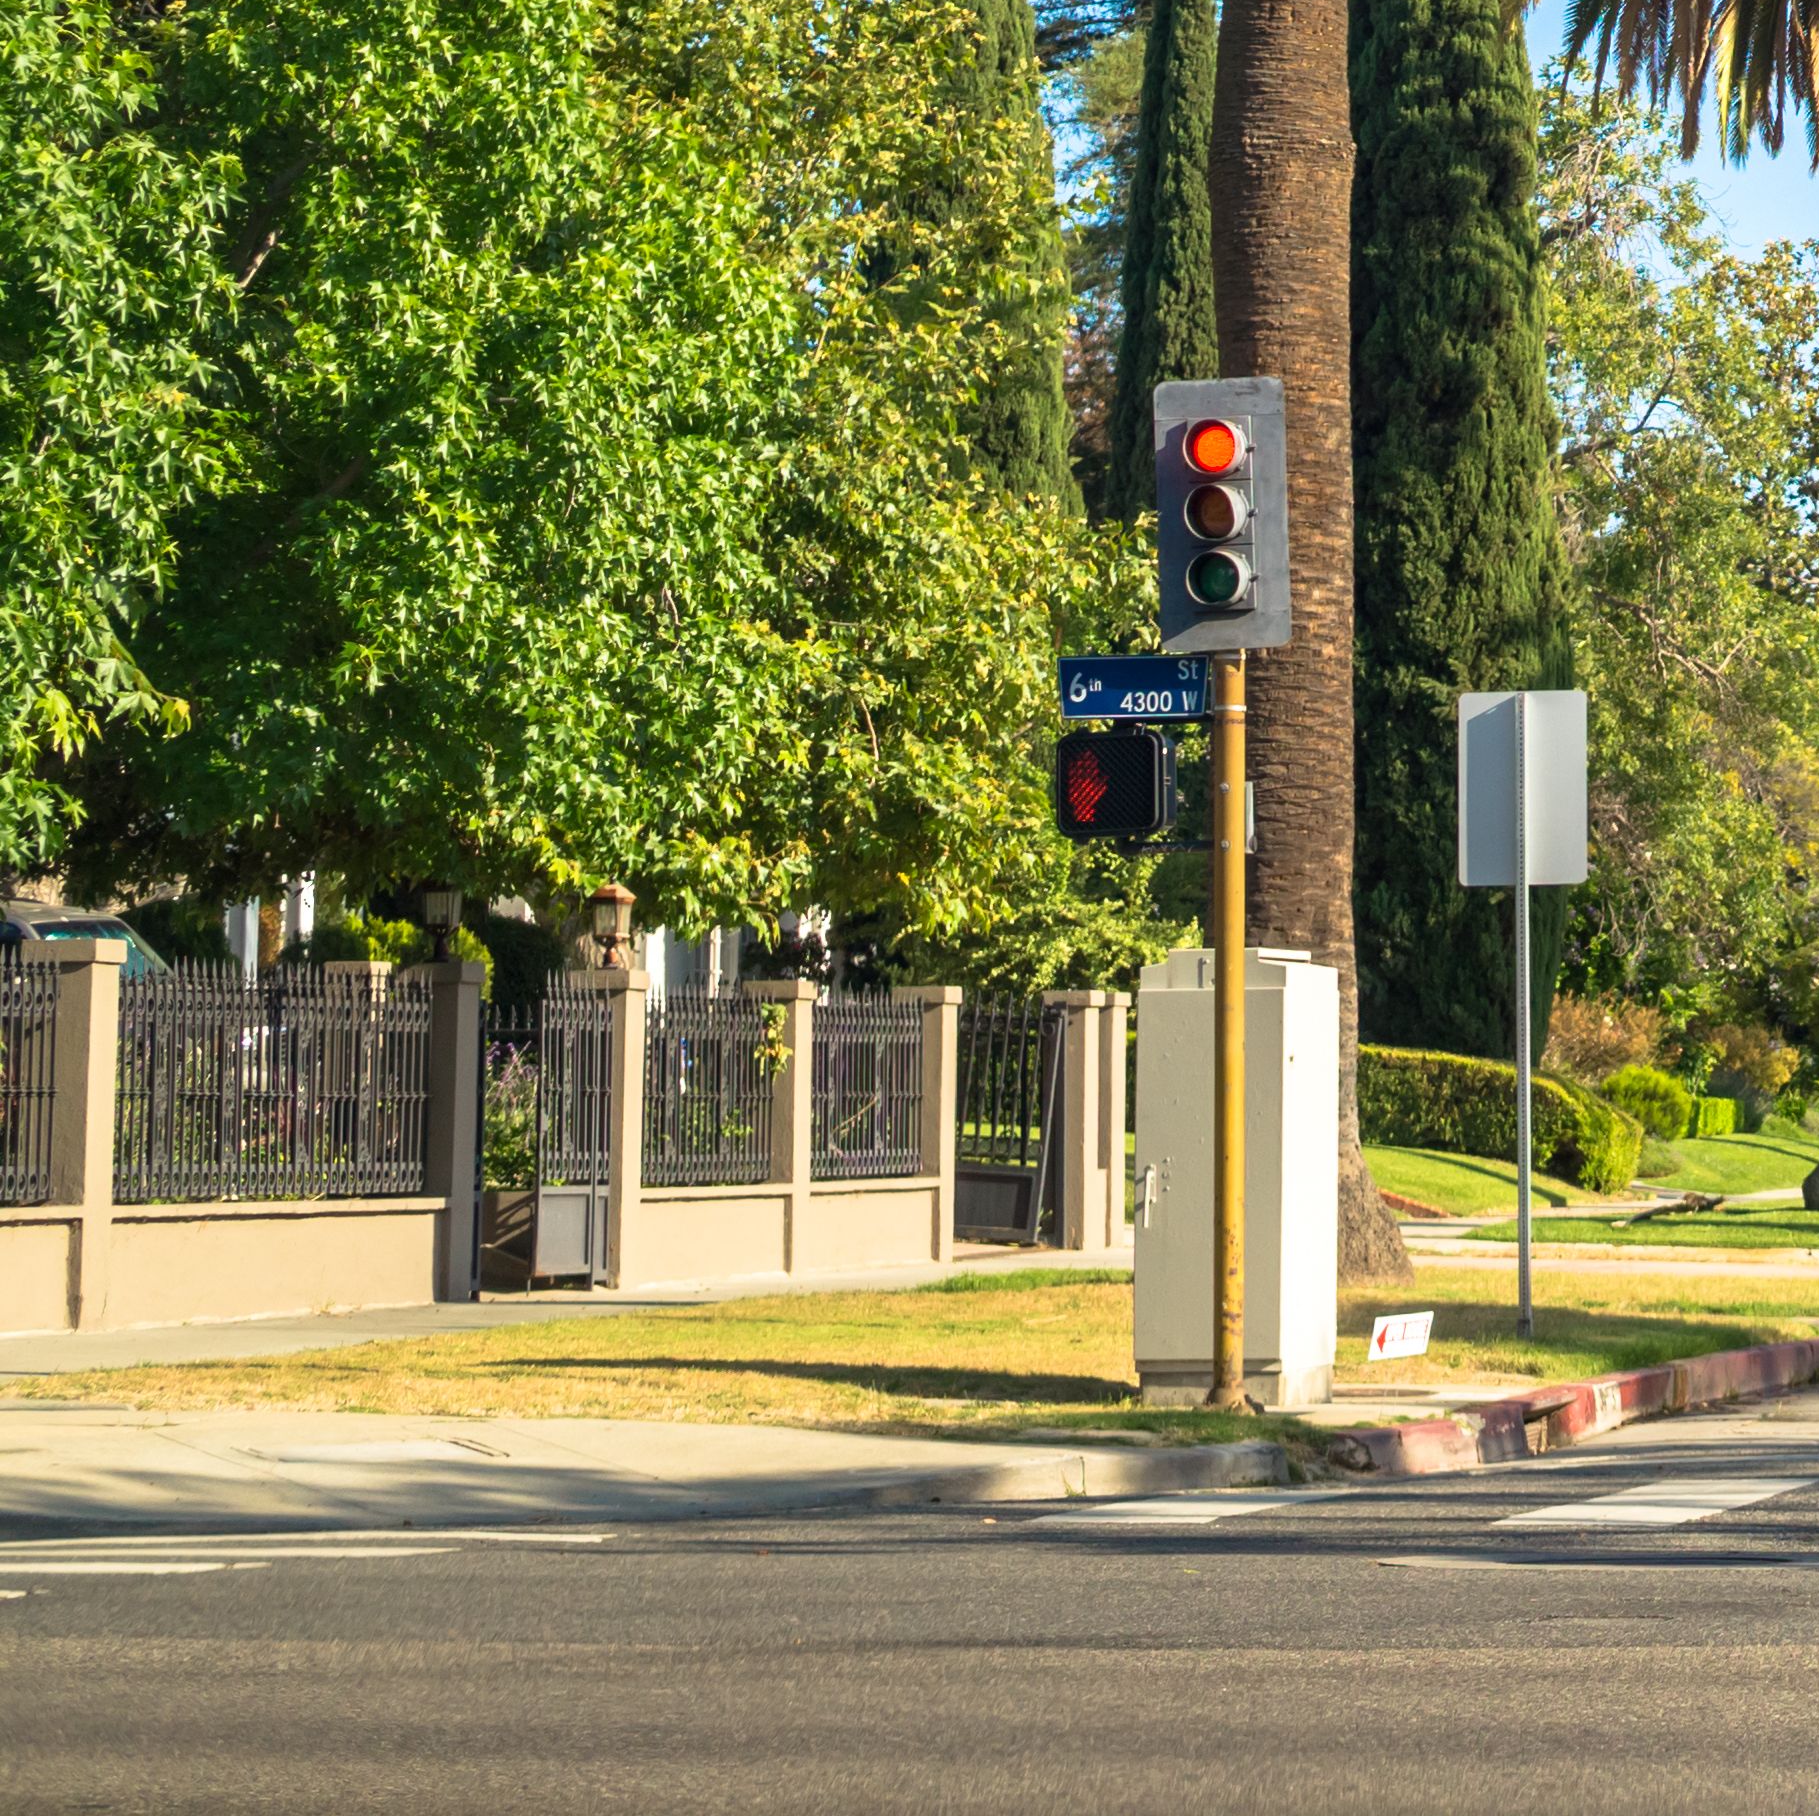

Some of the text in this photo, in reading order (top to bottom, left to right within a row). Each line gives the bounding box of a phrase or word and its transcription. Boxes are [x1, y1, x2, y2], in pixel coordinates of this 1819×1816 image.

[1177, 659, 1199, 680] St
[1069, 672, 1102, 703] 6th
[1120, 691, 1198, 713] 4300 W
